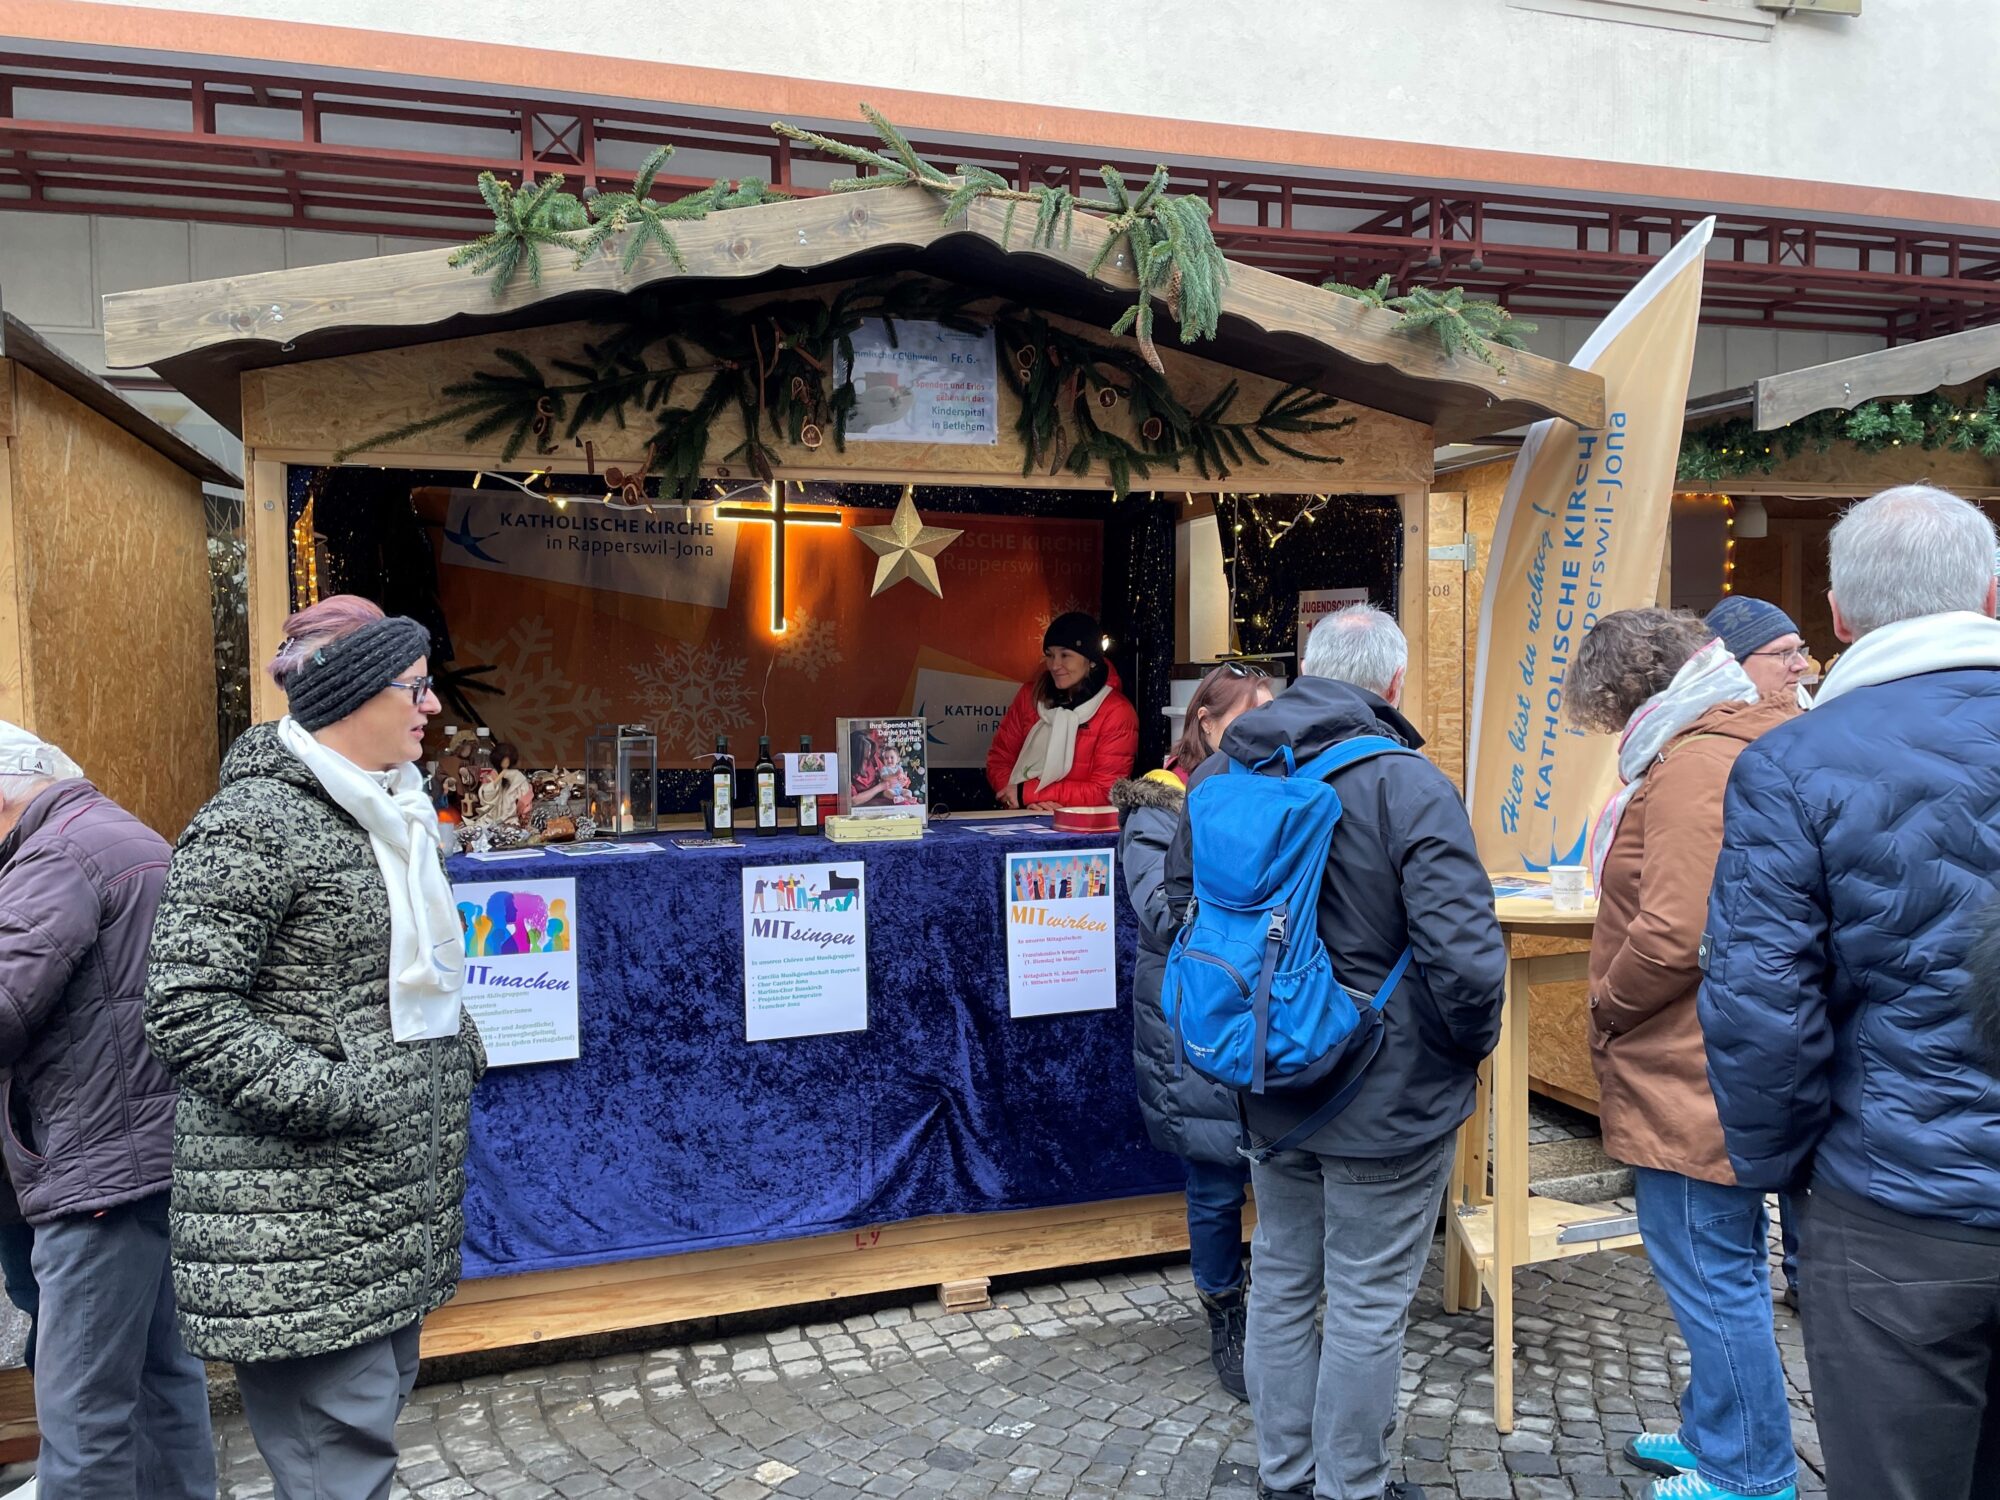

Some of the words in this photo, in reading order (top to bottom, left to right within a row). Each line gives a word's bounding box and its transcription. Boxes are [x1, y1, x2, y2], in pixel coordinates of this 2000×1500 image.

[951, 353, 964, 364] Fr.
[966, 353, 981, 364] 6.-
[914, 380, 948, 392] Spenden
[950, 382, 965, 390] und
[972, 394, 985, 403] das
[931, 405, 985, 419] Kinderspital
[932, 421, 941, 430] in
[943, 421, 985, 432] Betlehem
[501, 511, 639, 533] KATHOLISCHE
[645, 519, 714, 536] KIRCHE
[546, 534, 562, 550] in
[569, 535, 714, 559] Rapperswil-Jona
[1022, 536, 1093, 552] KIRCHE
[943, 557, 1092, 578] Rapperswil-Jona
[1534, 560, 1581, 811] KATHOLISCHE
[1564, 427, 1599, 548] KIRCH
[1519, 644, 1537, 686] du
[945, 705, 1007, 717] KATHOLI
[883, 722, 907, 730] Spende
[977, 720, 988, 732] in
[1508, 694, 1531, 752] bist
[1501, 763, 1525, 834] Hier
[1011, 905, 1108, 932] MITwirken
[751, 918, 856, 949] MITsingen
[464, 964, 570, 991] ITmachen
